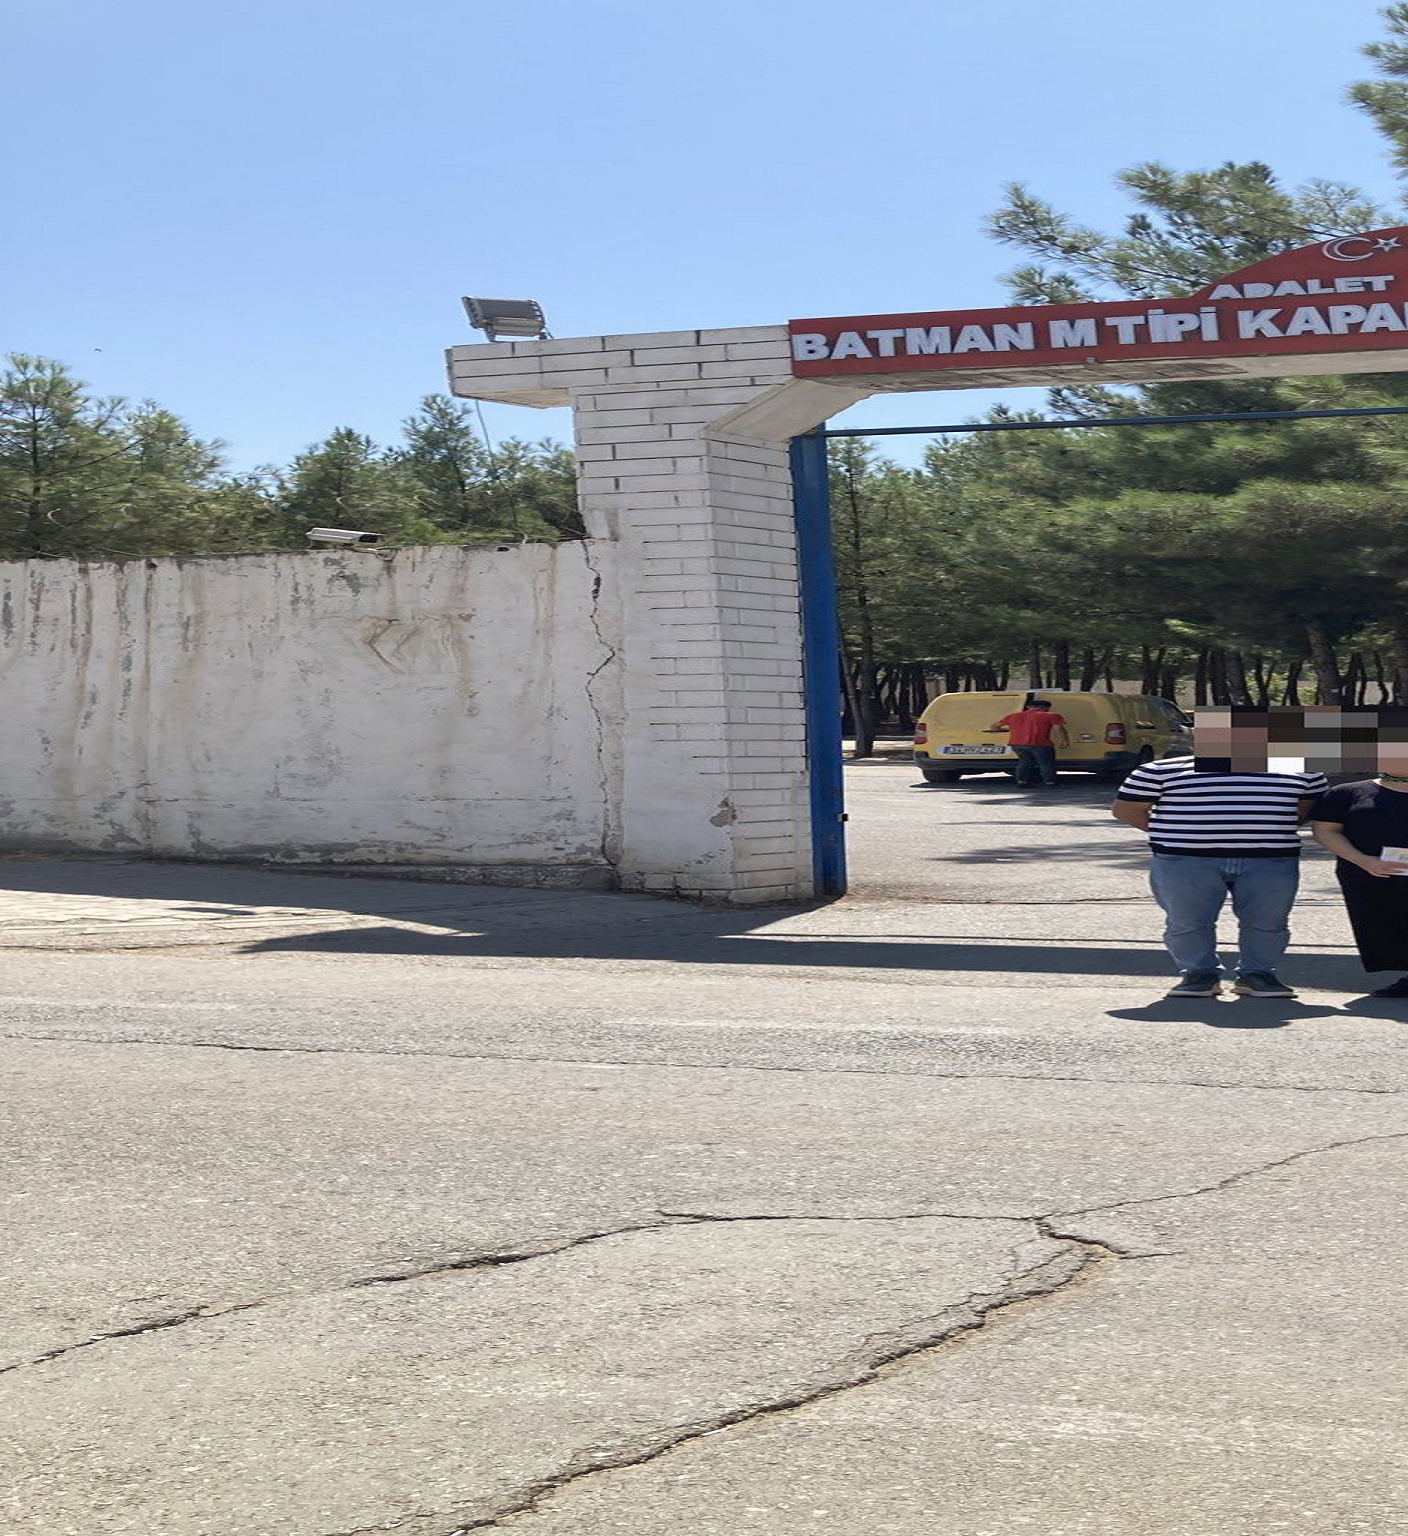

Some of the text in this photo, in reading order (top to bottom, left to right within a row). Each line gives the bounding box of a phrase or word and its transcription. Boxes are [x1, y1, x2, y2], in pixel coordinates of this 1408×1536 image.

[1209, 275, 1394, 300] ADALET
[793, 322, 1034, 361] BATMAN
[1050, 318, 1097, 348] M
[1106, 307, 1219, 345] TİPİ
